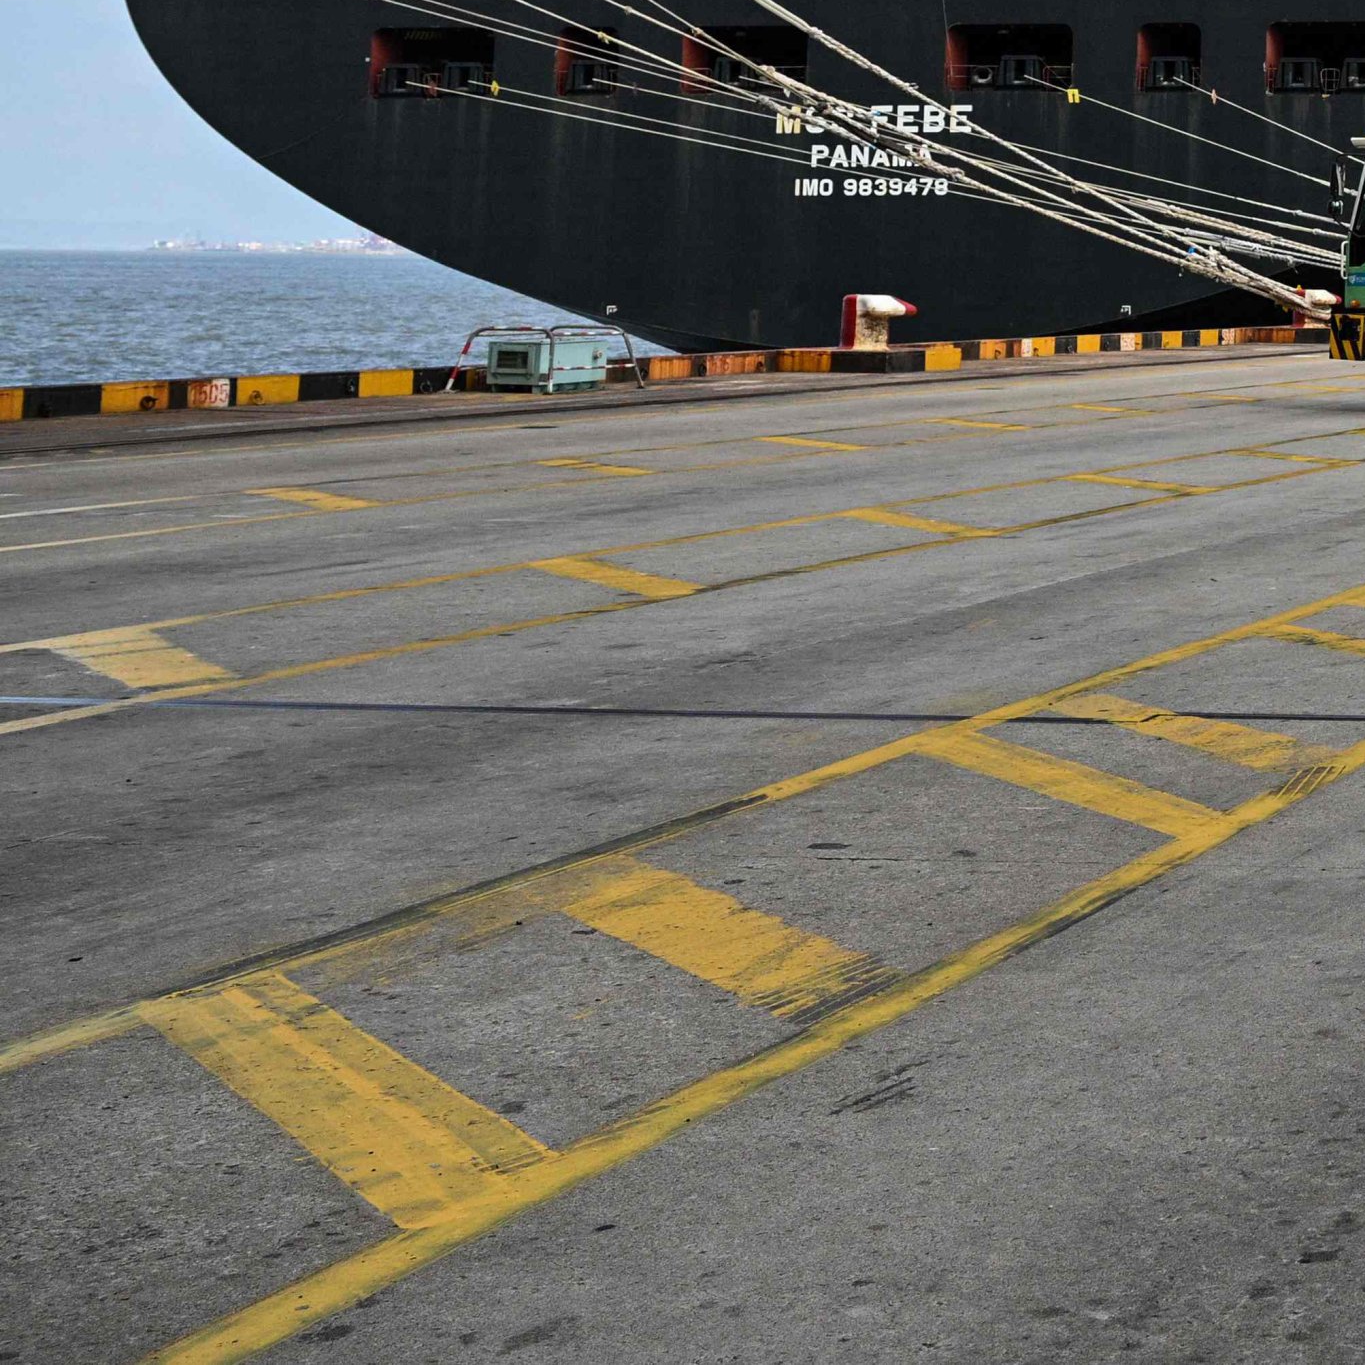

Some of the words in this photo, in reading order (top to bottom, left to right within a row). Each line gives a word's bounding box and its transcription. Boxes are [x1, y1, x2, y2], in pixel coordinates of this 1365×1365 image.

[871, 105, 973, 134] FEBE
[795, 179, 833, 196] IMO
[843, 178, 949, 196] 9839478
